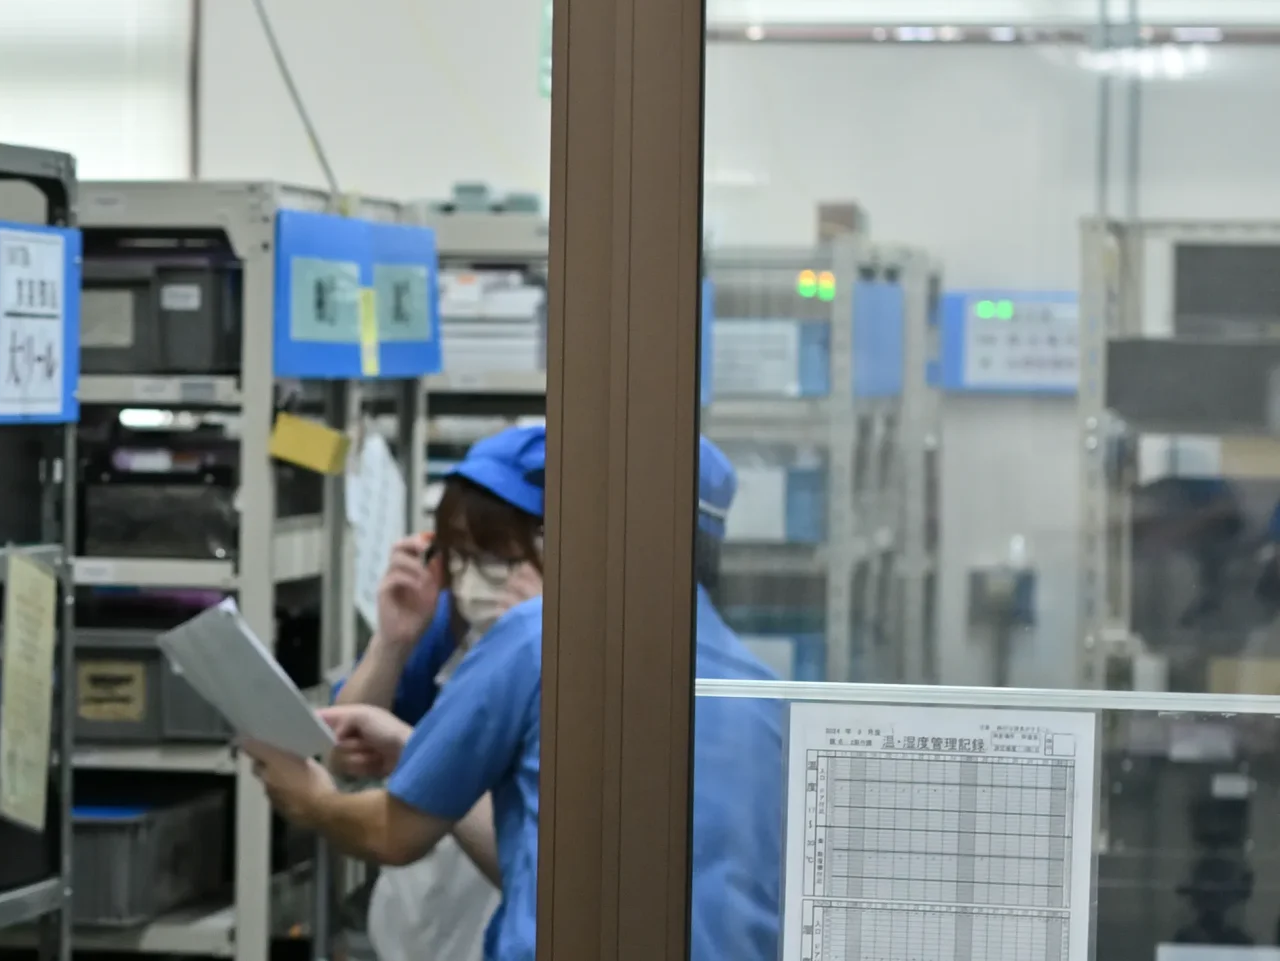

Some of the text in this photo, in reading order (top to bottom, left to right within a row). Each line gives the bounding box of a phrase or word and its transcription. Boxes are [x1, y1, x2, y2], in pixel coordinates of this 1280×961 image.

[882, 735, 985, 752] 温・湿度管理記録
